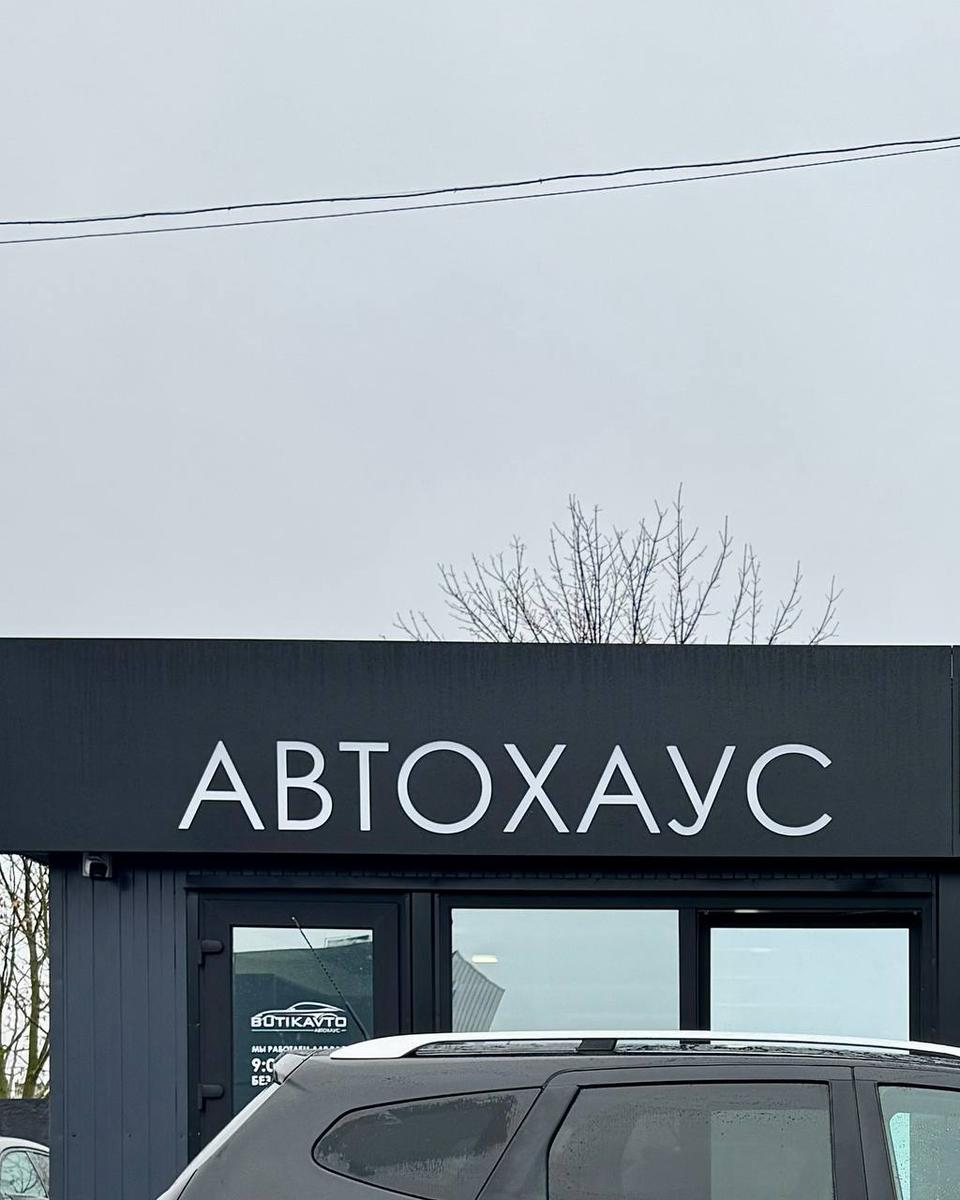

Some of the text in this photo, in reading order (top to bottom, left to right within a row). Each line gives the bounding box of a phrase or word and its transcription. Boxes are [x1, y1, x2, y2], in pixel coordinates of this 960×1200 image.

[178, 740, 833, 836] АВТОХАУС
[251, 1016, 347, 1028] BUTIKAVTO
[251, 1058, 275, 1073] 9:0
